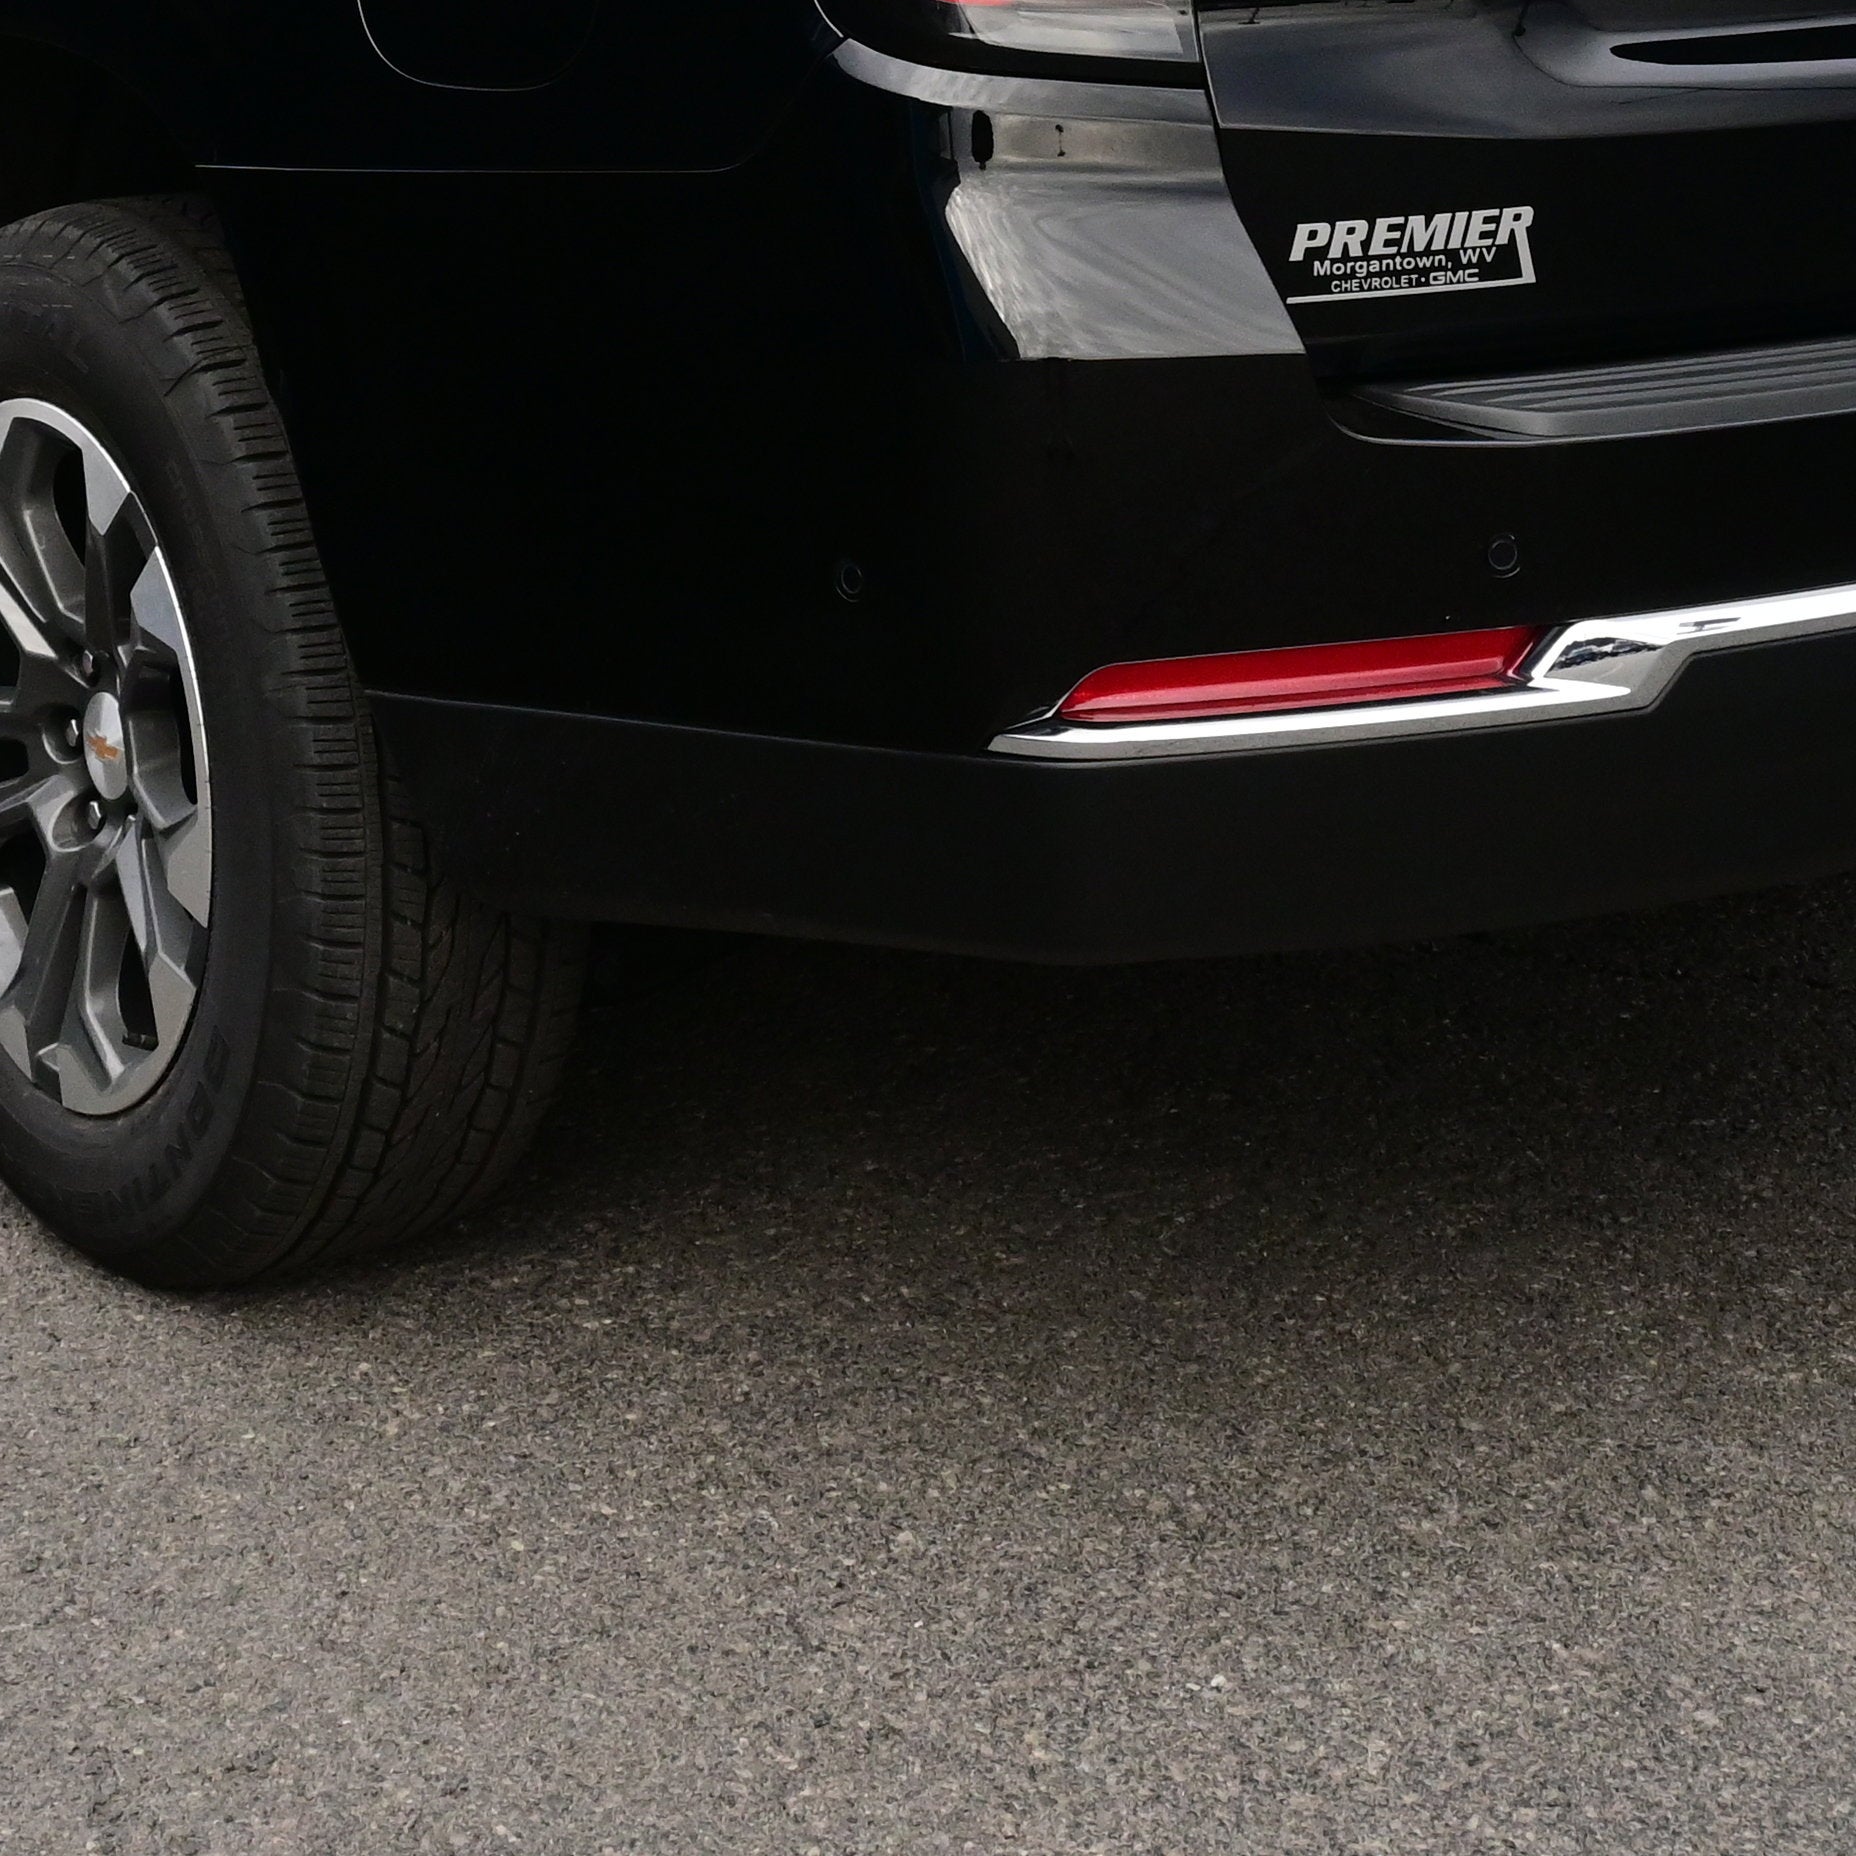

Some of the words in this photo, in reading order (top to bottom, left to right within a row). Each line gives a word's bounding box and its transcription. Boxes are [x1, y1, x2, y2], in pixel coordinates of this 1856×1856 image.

[1288, 205, 1535, 263] PREMIER
[1312, 254, 1453, 280] Morgantown,
[1459, 246, 1497, 265] WV
[1330, 274, 1419, 293] CHEVROLET
[1428, 268, 1480, 286] GMC
